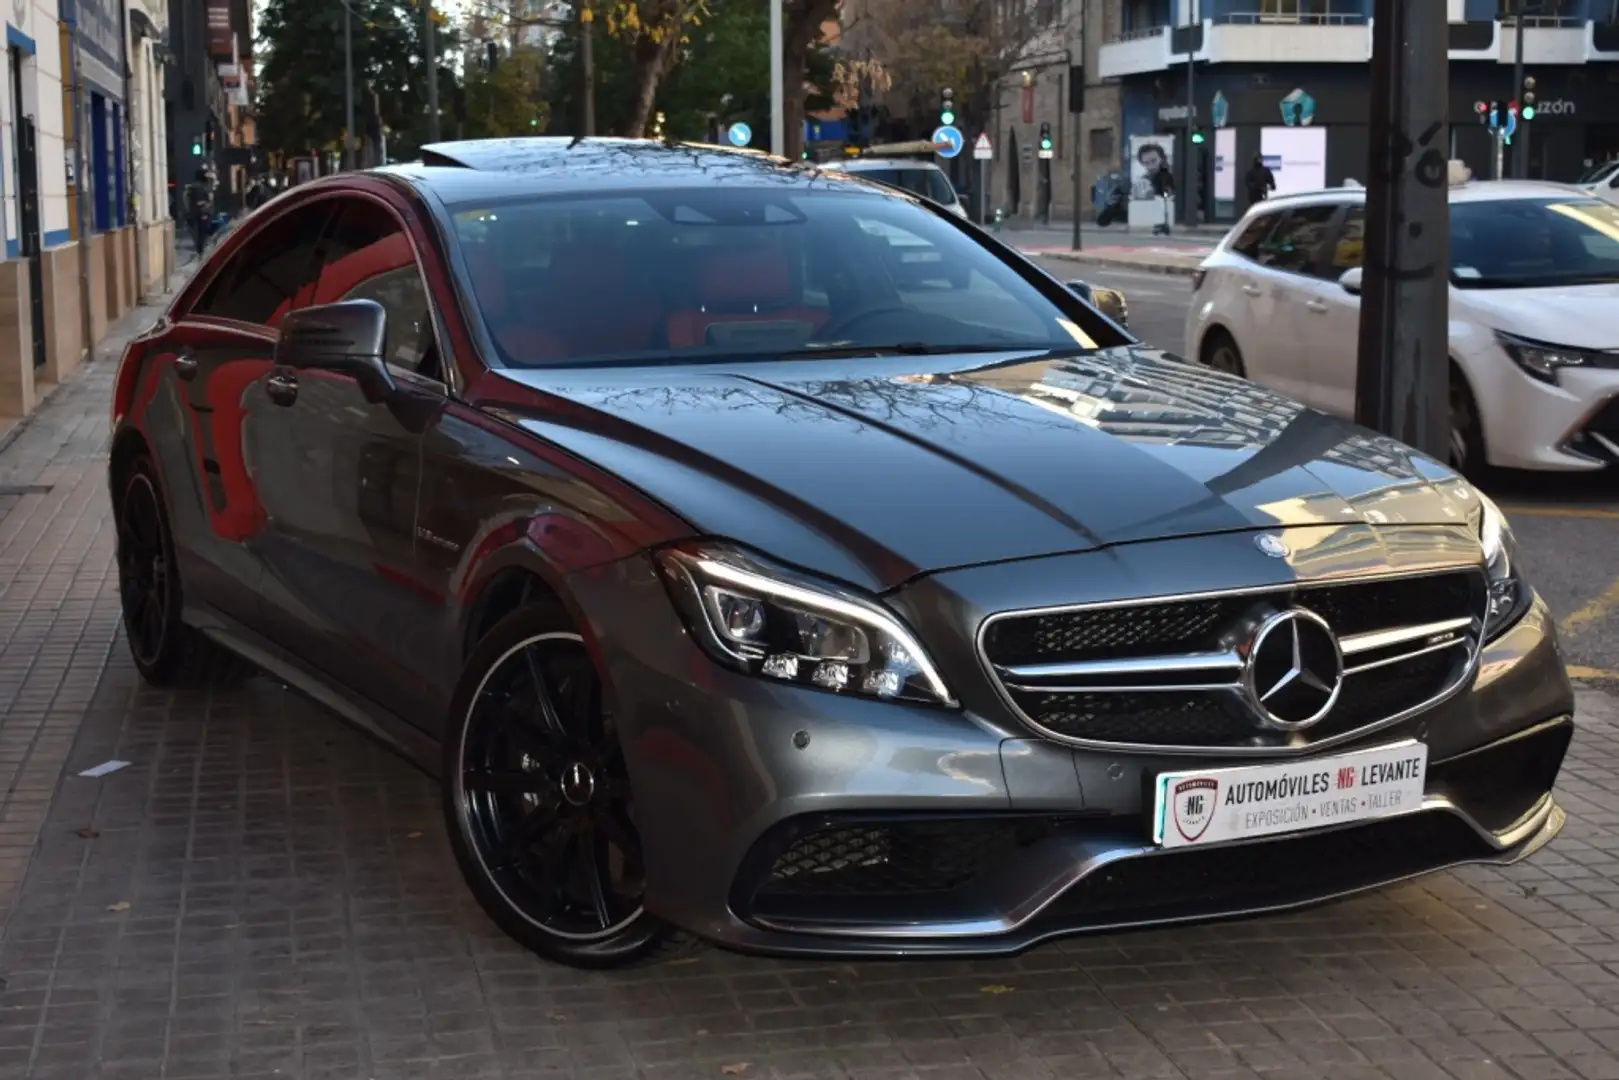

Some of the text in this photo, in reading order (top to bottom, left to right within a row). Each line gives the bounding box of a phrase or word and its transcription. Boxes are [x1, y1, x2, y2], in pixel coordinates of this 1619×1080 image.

[1225, 757, 1421, 806] AUTOMÓVILES NG LEVANTE
[1186, 794, 1203, 816] NG
[1245, 789, 1402, 829] EXPOSICIÓN VENTAS TALLER
